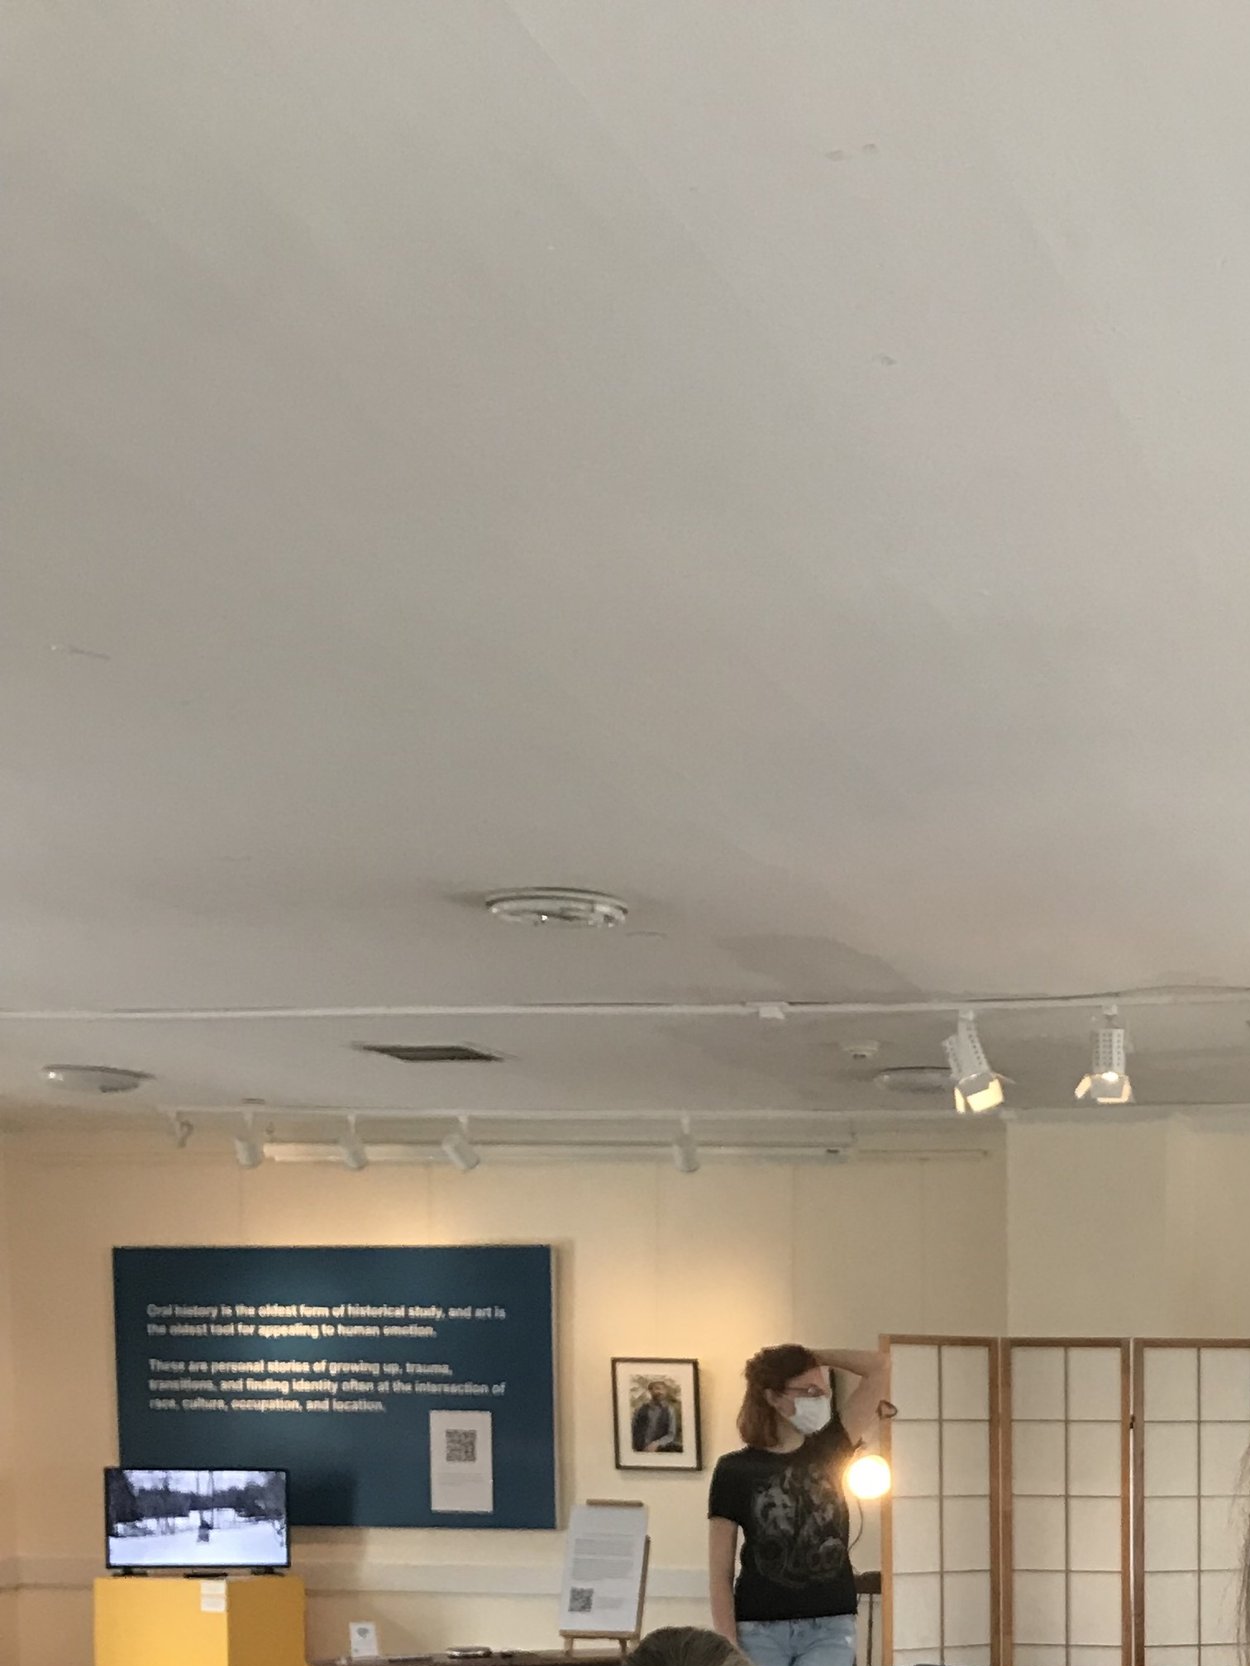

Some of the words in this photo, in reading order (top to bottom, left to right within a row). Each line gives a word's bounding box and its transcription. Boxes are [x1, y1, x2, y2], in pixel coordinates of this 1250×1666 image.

[147, 1303, 172, 1318] Oral
[174, 1304, 218, 1319] history
[221, 1304, 232, 1318] is
[235, 1304, 255, 1318] the
[258, 1303, 298, 1318] oldest
[300, 1304, 330, 1318] form
[332, 1304, 346, 1318] of
[347, 1303, 405, 1319] historical
[408, 1305, 445, 1320] study,
[448, 1306, 472, 1319] and
[475, 1307, 492, 1319] art
[494, 1306, 506, 1319] is
[147, 1323, 166, 1336] the
[169, 1323, 207, 1336] oldest
[210, 1323, 235, 1336] tool
[237, 1322, 256, 1336] for
[258, 1322, 319, 1339] appealing
[321, 1323, 335, 1337] to
[337, 1323, 380, 1337] human
[383, 1324, 437, 1338] emotion.
[149, 1358, 185, 1373] These
[188, 1361, 208, 1373] are
[211, 1359, 265, 1375] personal
[267, 1359, 310, 1373] stories
[312, 1359, 327, 1373] of
[329, 1360, 380, 1376] growing
[383, 1362, 403, 1377] up,
[405, 1361, 453, 1376] trauma,
[148, 1377, 217, 1392] transitions,
[220, 1378, 244, 1392] and
[246, 1377, 290, 1395] finding
[292, 1378, 338, 1395] identity
[341, 1378, 374, 1393] often
[377, 1380, 390, 1393] at
[392, 1379, 412, 1394] the
[415, 1380, 489, 1396] intersection
[491, 1381, 506, 1396] of
[149, 1398, 180, 1412] race,
[182, 1397, 229, 1412] culture,
[231, 1397, 303, 1413] occupation,
[305, 1398, 330, 1412] and
[332, 1398, 386, 1412] location.
